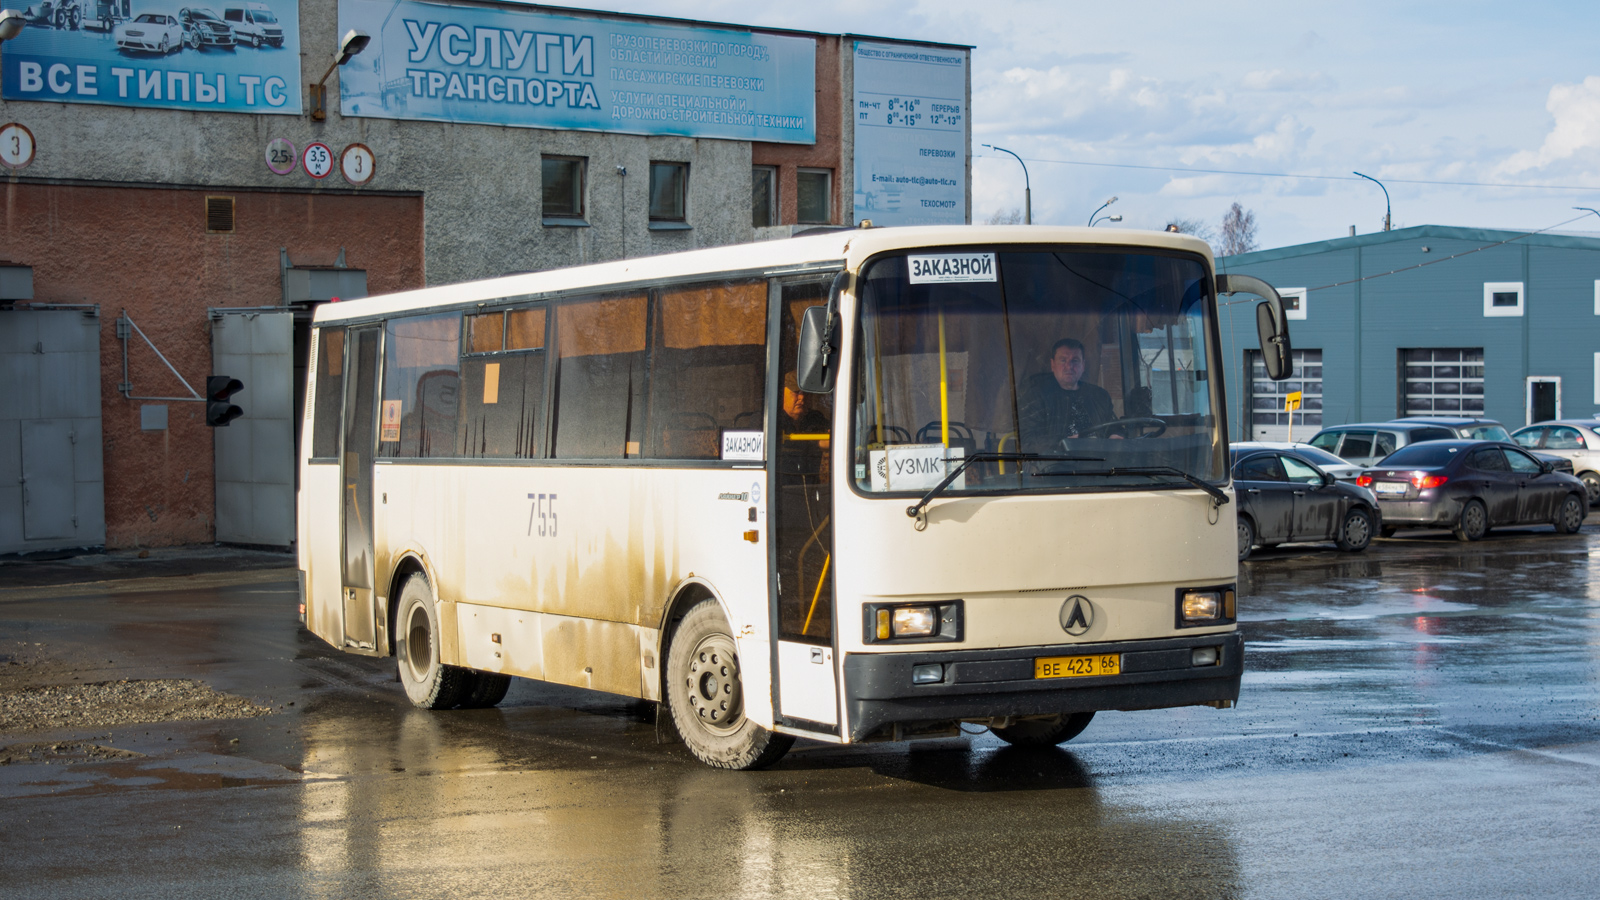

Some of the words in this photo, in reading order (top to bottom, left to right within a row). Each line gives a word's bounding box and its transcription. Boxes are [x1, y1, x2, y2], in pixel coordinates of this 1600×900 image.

[404, 19, 594, 76] УСЛУГИ
[610, 33, 708, 53] ГРУЗОПЕРЕВОЗКИ
[711, 42, 726, 54] ПО
[728, 43, 769, 61] ГОРОДУ,
[858, 48, 881, 57] ОБЩЕСТВО
[886, 51, 918, 60] ОГРАНИЧЕННОЙ
[919, 54, 961, 64] ОТВЕТСТВЕННОСТЬЮ
[610, 49, 661, 64] ОБЛАСТИ
[664, 52, 671, 64] И
[674, 53, 717, 68] РОССИИ
[20, 61, 98, 96] ВСЕ
[111, 67, 226, 104] ТИПЫ
[239, 75, 287, 107] ТС
[407, 69, 600, 109] ТРАНСПОРТА
[610, 68, 700, 86] ПАССАЖИРСКИЕ
[703, 74, 764, 91] ПЕРЕВОЗКИ
[611, 90, 653, 105] УСЛУГИ
[657, 93, 736, 110] СПЕЦИАЛЬНОЙ
[738, 99, 746, 111] И
[931, 104, 959, 113] ПЕРЕРЫВ
[611, 106, 755, 126] ДОРОЖНО-СТРОИТЕЛЬНОЙ
[757, 114, 803, 129] ТЕХНИКИ
[11, 136, 20, 156] 3
[919, 148, 955, 158] ПЕРЕВОЗКИ
[355, 155, 362, 173] 3
[872, 174, 895, 182] E-mail:
[895, 176, 956, 186] auto-tlc@auto-tlc.ru
[920, 199, 956, 208] ТЕХОСМОТР
[913, 255, 992, 276] ЗАКАЗНОЙ
[725, 434, 762, 453] ЗАКАЗНОЙ
[894, 457, 939, 475] УЗМК
[527, 493, 557, 537] 755
[1043, 663, 1060, 676] ВЕ
[1067, 658, 1093, 674] 423
[1102, 656, 1114, 668] 66
